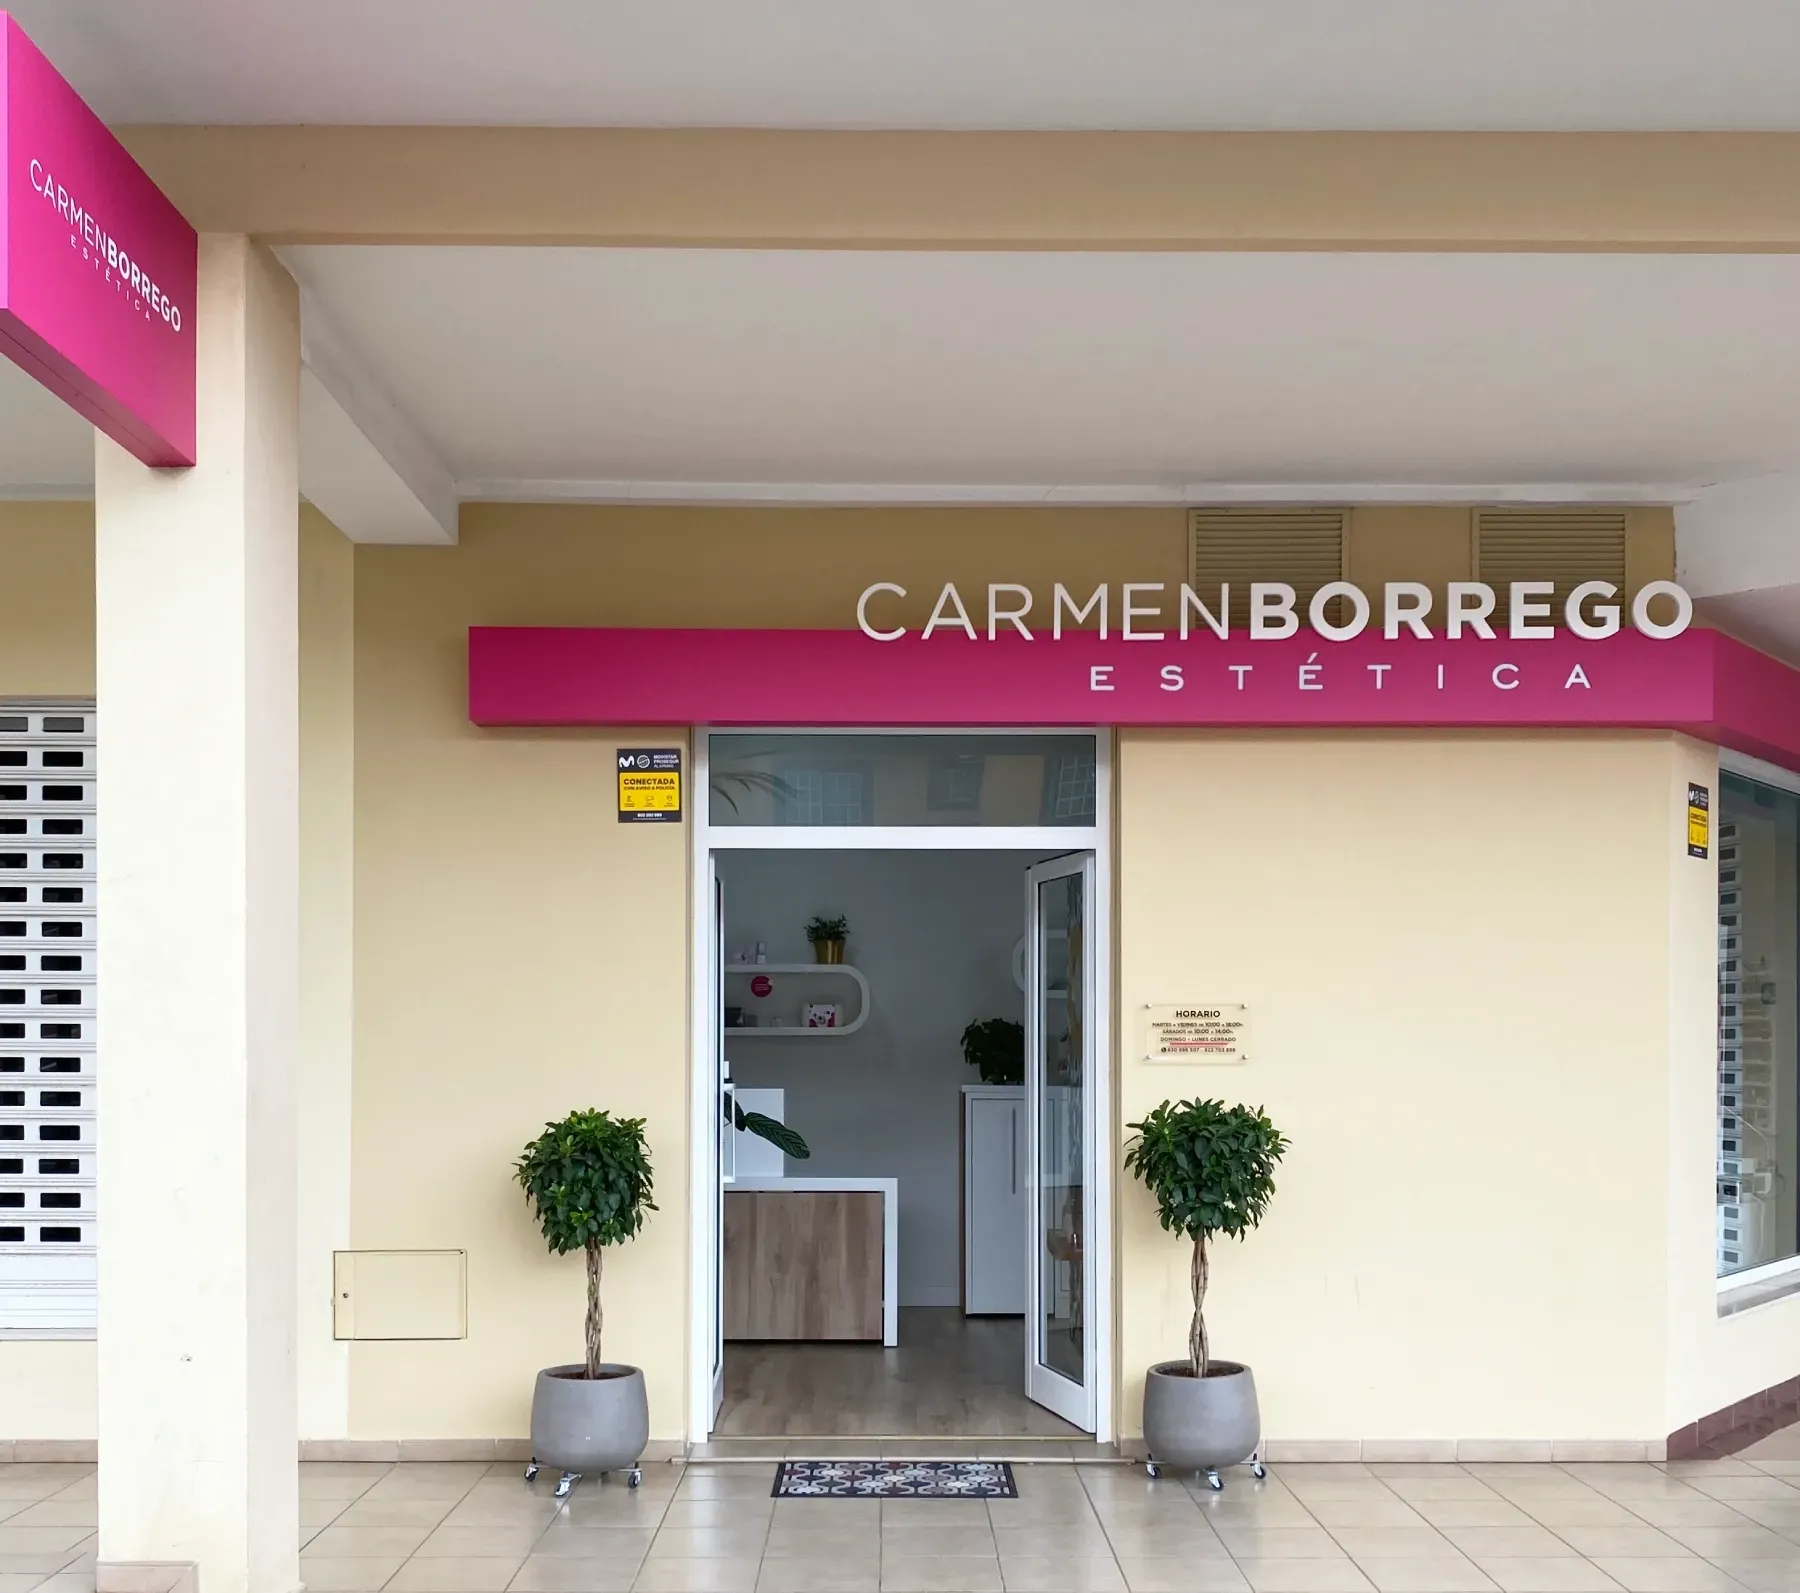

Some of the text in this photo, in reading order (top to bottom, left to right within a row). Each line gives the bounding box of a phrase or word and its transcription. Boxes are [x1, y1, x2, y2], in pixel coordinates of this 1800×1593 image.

[29, 158, 182, 332] CARMENBORREGO
[69, 234, 151, 322] ESTÉTICA
[855, 579, 1694, 642] CARMENBORREGO
[1088, 652, 1594, 692] ESTÉTICA
[1175, 1010, 1221, 1018] HORARIO
